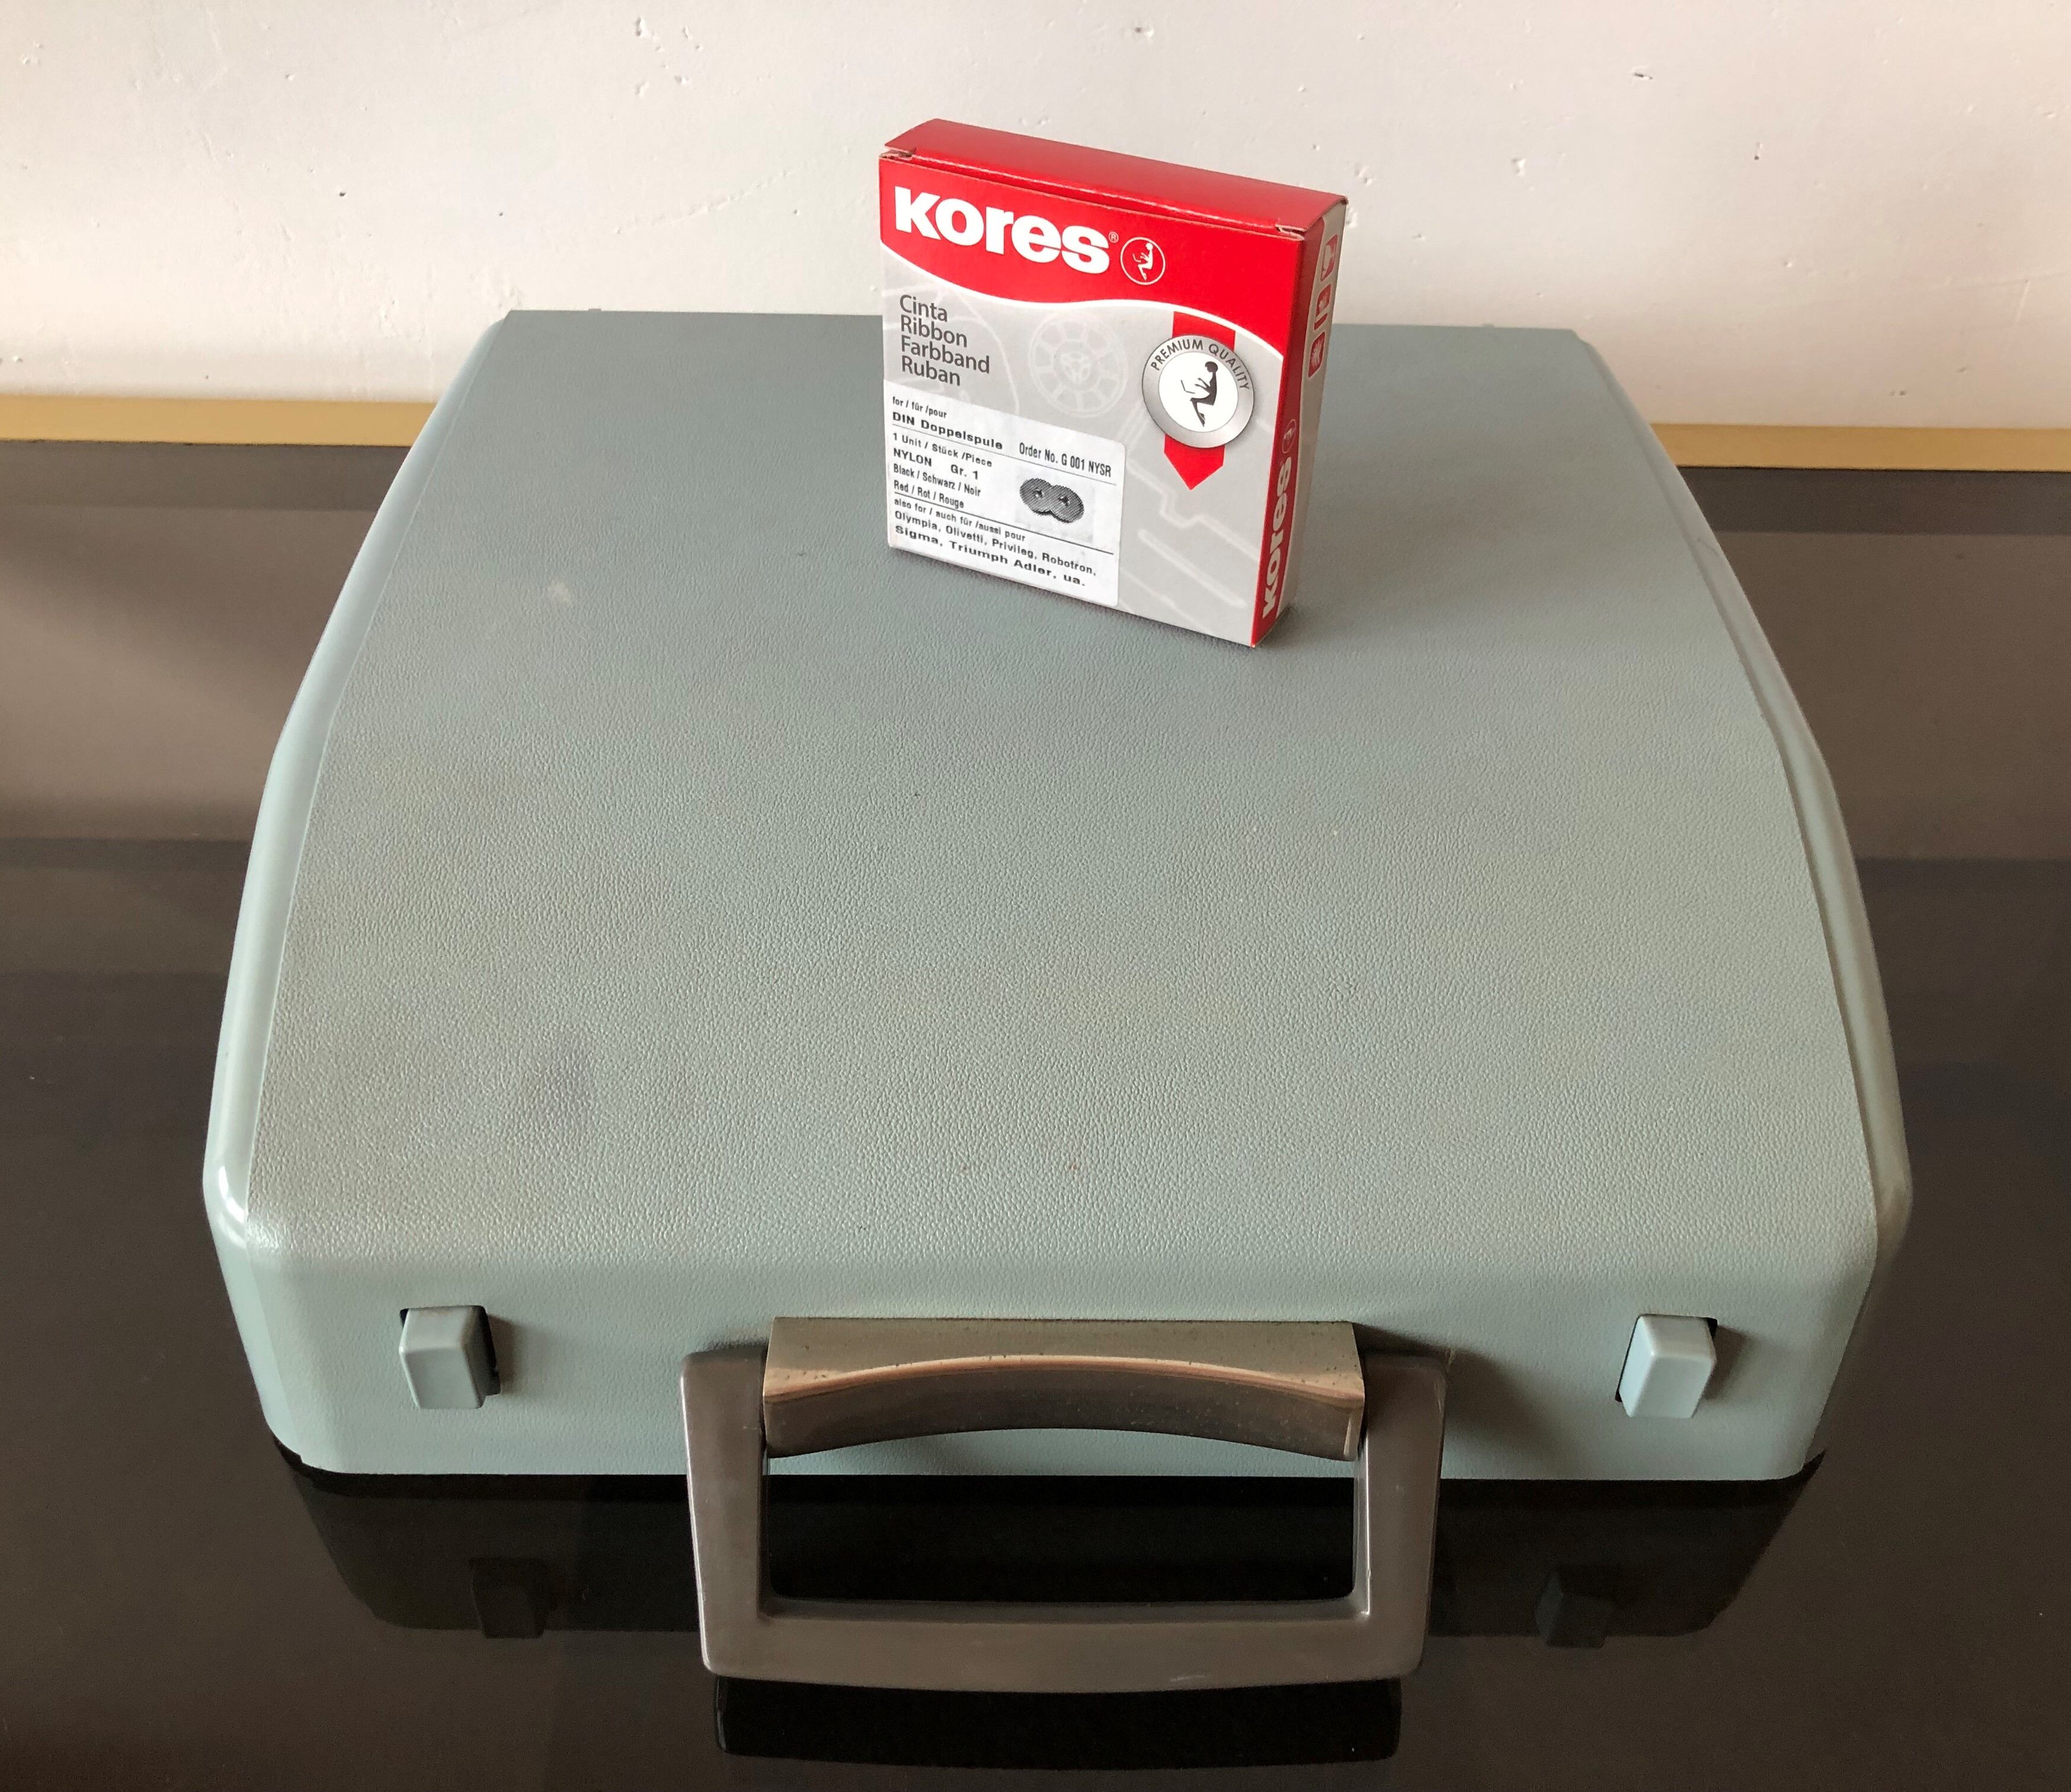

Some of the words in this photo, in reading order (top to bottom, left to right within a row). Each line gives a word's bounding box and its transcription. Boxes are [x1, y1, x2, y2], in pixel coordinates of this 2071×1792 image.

[900, 295, 948, 322] Cinta
[901, 314, 968, 348] Ribbon
[901, 334, 990, 374] Farbband
[901, 355, 961, 386] Ruban
[1150, 339, 1203, 372] PREMIUM
[1209, 344, 1250, 390] QUALITY
[892, 396, 904, 407] for
[911, 402, 923, 412] für
[892, 411, 915, 426] DIN
[921, 419, 1003, 450] Doppelspule
[893, 433, 897, 441] 1
[902, 434, 921, 448] Unit
[932, 443, 959, 458] Stück
[894, 447, 932, 467] NYLON
[950, 464, 967, 478] Gr.
[972, 470, 978, 480] 1
[1019, 442, 1042, 459] Order
[1044, 449, 1058, 464] No.
[1061, 453, 1067, 466] G
[1070, 455, 1085, 471] 001
[1088, 460, 1112, 478] NYSR
[894, 463, 915, 478] Black
[922, 472, 956, 490] Schwarz
[964, 484, 981, 497] Noir
[894, 479, 909, 493] Red
[917, 486, 930, 500] Rot
[939, 492, 965, 509] Rouge
[894, 498, 912, 509] also
[914, 503, 927, 513] for
[936, 510, 956, 523] auch
[960, 516, 972, 527] für
[1004, 530, 1026, 542] pour
[895, 510, 942, 533] Olympia,
[946, 525, 988, 546] Olivetti,
[992, 537, 1038, 560] Privileg,
[1042, 552, 1096, 576] Robotron,
[895, 525, 943, 547] Sigma,
[949, 540, 1008, 564] Triumph
[1013, 559, 1057, 580] Adler,
[1063, 574, 1086, 587] ua.
